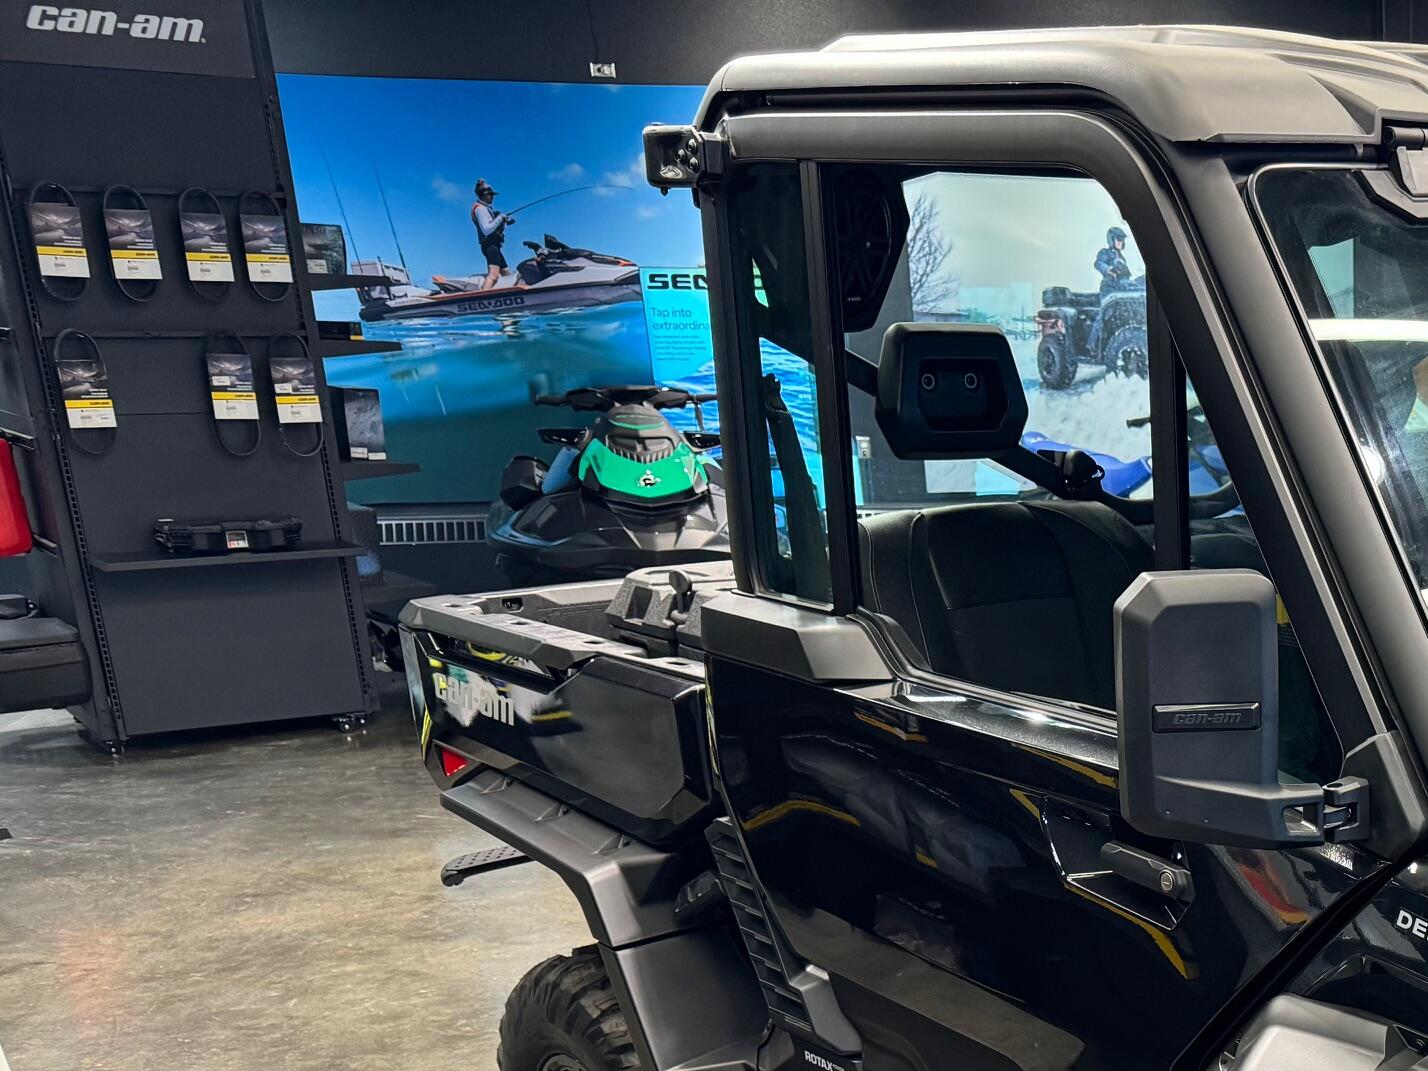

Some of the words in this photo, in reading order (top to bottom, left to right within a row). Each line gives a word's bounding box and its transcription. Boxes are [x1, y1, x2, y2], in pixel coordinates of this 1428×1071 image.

[26, 5, 204, 42] can-am
[651, 308, 670, 319] Tap
[671, 307, 693, 317] into
[1173, 713, 1242, 724] can-am
